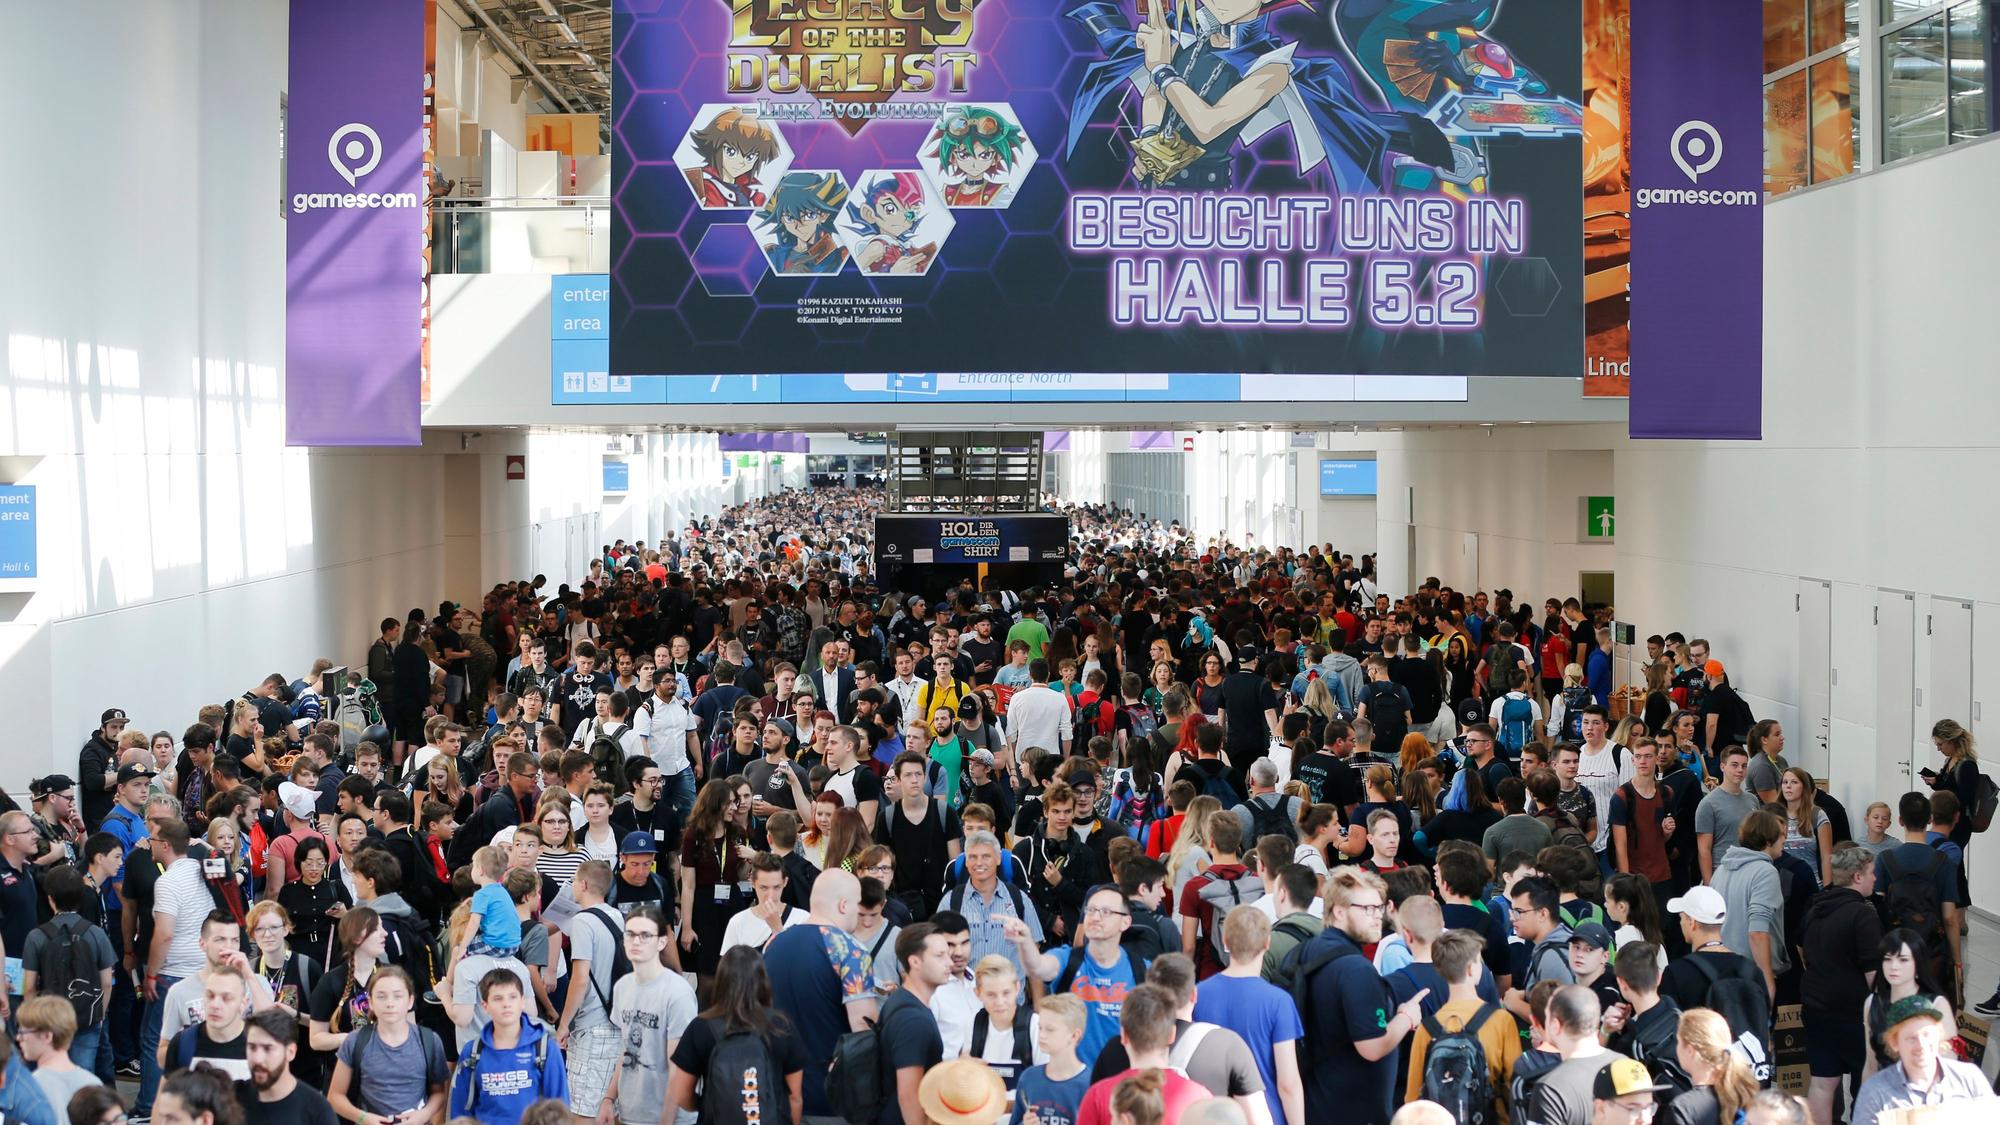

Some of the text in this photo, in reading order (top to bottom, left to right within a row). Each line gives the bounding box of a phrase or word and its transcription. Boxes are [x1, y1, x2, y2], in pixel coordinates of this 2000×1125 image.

[802, 28, 906, 47] OF THE
[728, 53, 977, 93] DUELIST
[757, 99, 947, 122] LINK EVOLUTION
[293, 191, 416, 213] gamescom
[1636, 188, 1757, 208] gamescom
[1072, 197, 1523, 253] BESUCHT UNS IN
[563, 288, 609, 302] enter
[1113, 259, 1479, 327] HALLE 5.2
[563, 318, 601, 331] area
[797, 316, 829, 324] ©Konami
[831, 316, 853, 325] Digital
[958, 373, 1072, 384] Entrance North
[1, 511, 30, 520] area
[941, 522, 978, 536] HOL
[940, 537, 1000, 549] gamescom
[964, 547, 1000, 556] SHIRT
[2, 562, 30, 571] Hall 6
